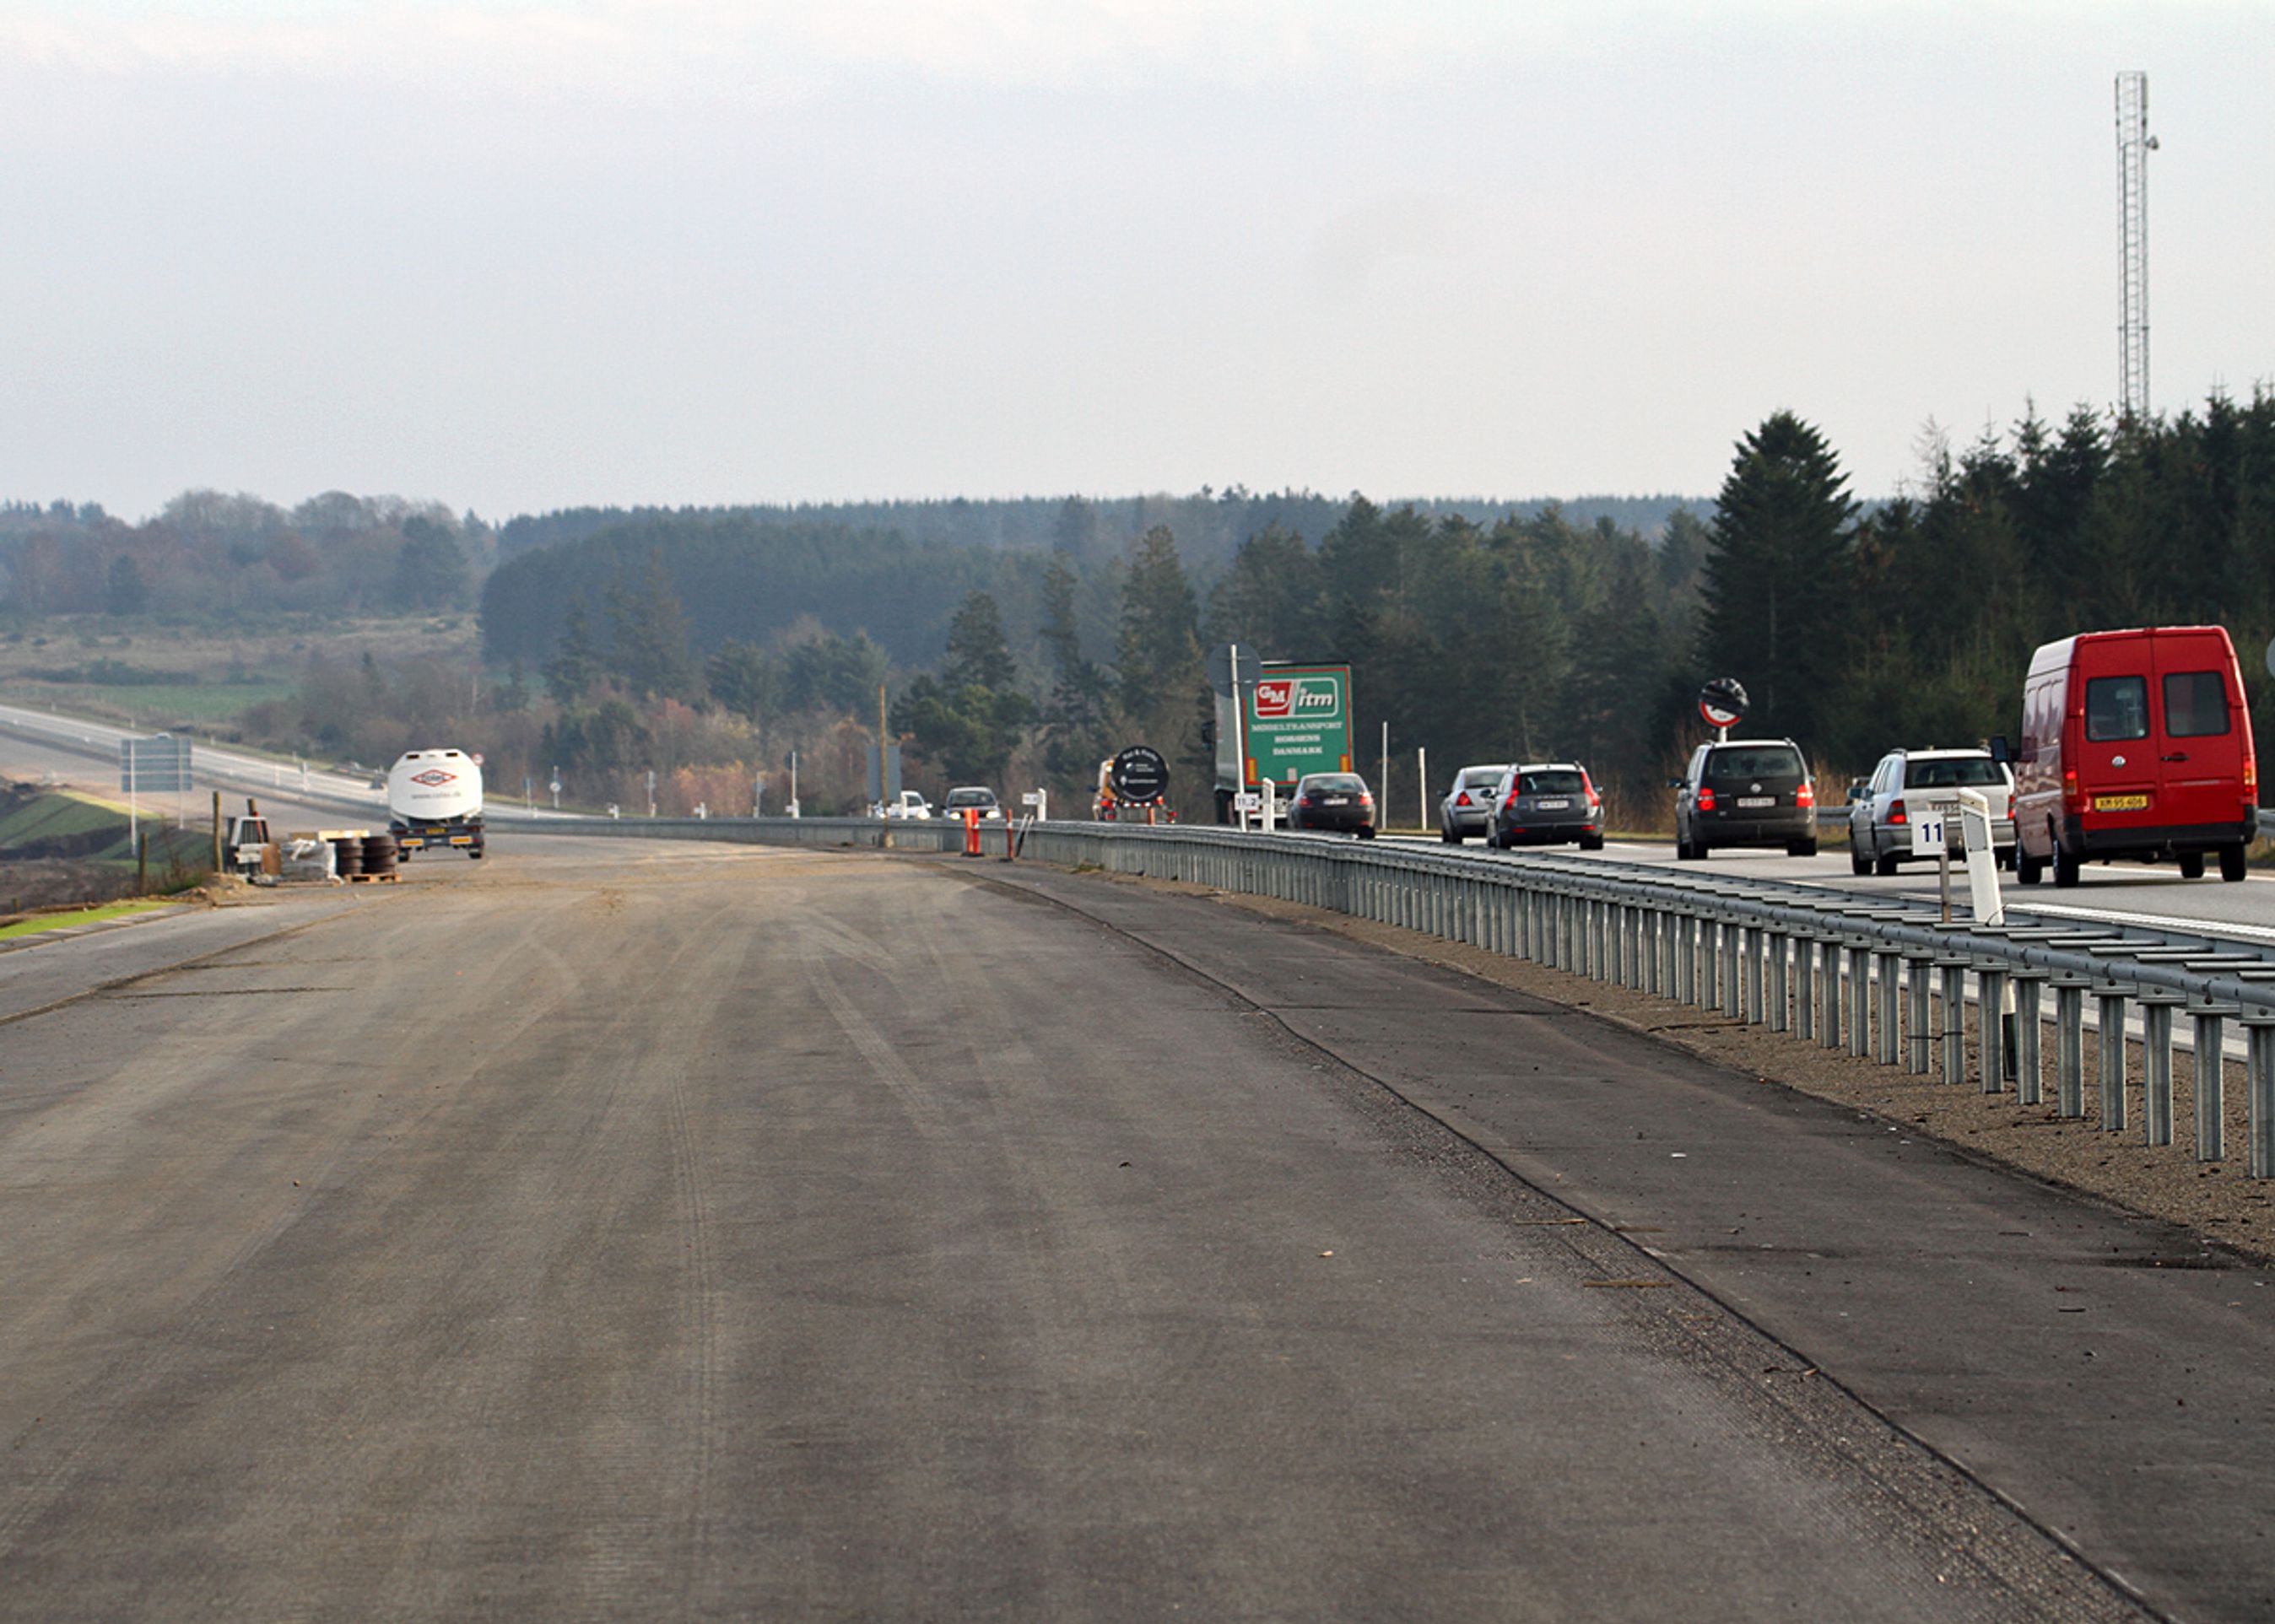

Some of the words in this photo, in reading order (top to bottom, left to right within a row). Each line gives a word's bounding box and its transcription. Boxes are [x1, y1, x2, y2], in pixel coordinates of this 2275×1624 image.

[1299, 688, 1333, 706] itm
[1273, 747, 1323, 756] DANMARK
[1921, 823, 1943, 843] 11
